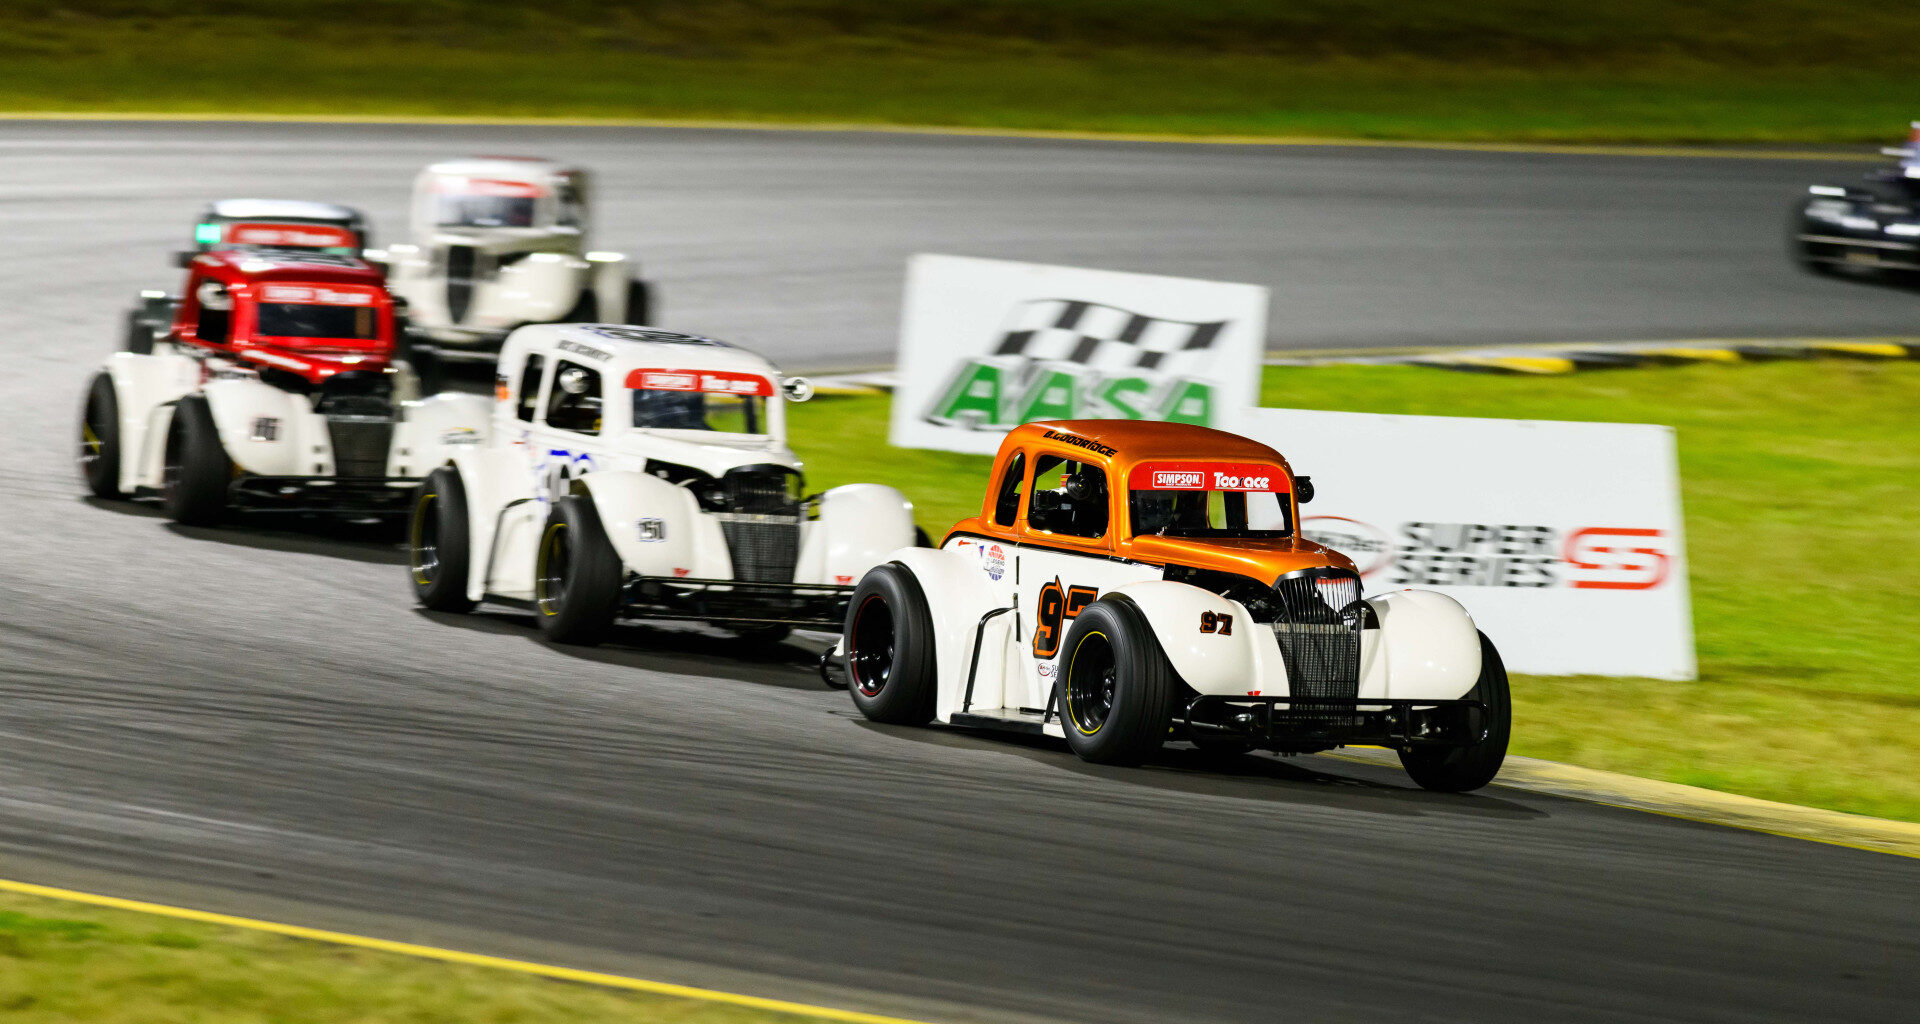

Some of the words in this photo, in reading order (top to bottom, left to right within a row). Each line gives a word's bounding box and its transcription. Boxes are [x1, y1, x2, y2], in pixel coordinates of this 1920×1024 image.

[926, 360, 1218, 428] AASA
[1399, 521, 1557, 554] SUPER
[1391, 555, 1557, 588] SERIES
[1199, 610, 1233, 636] 97
